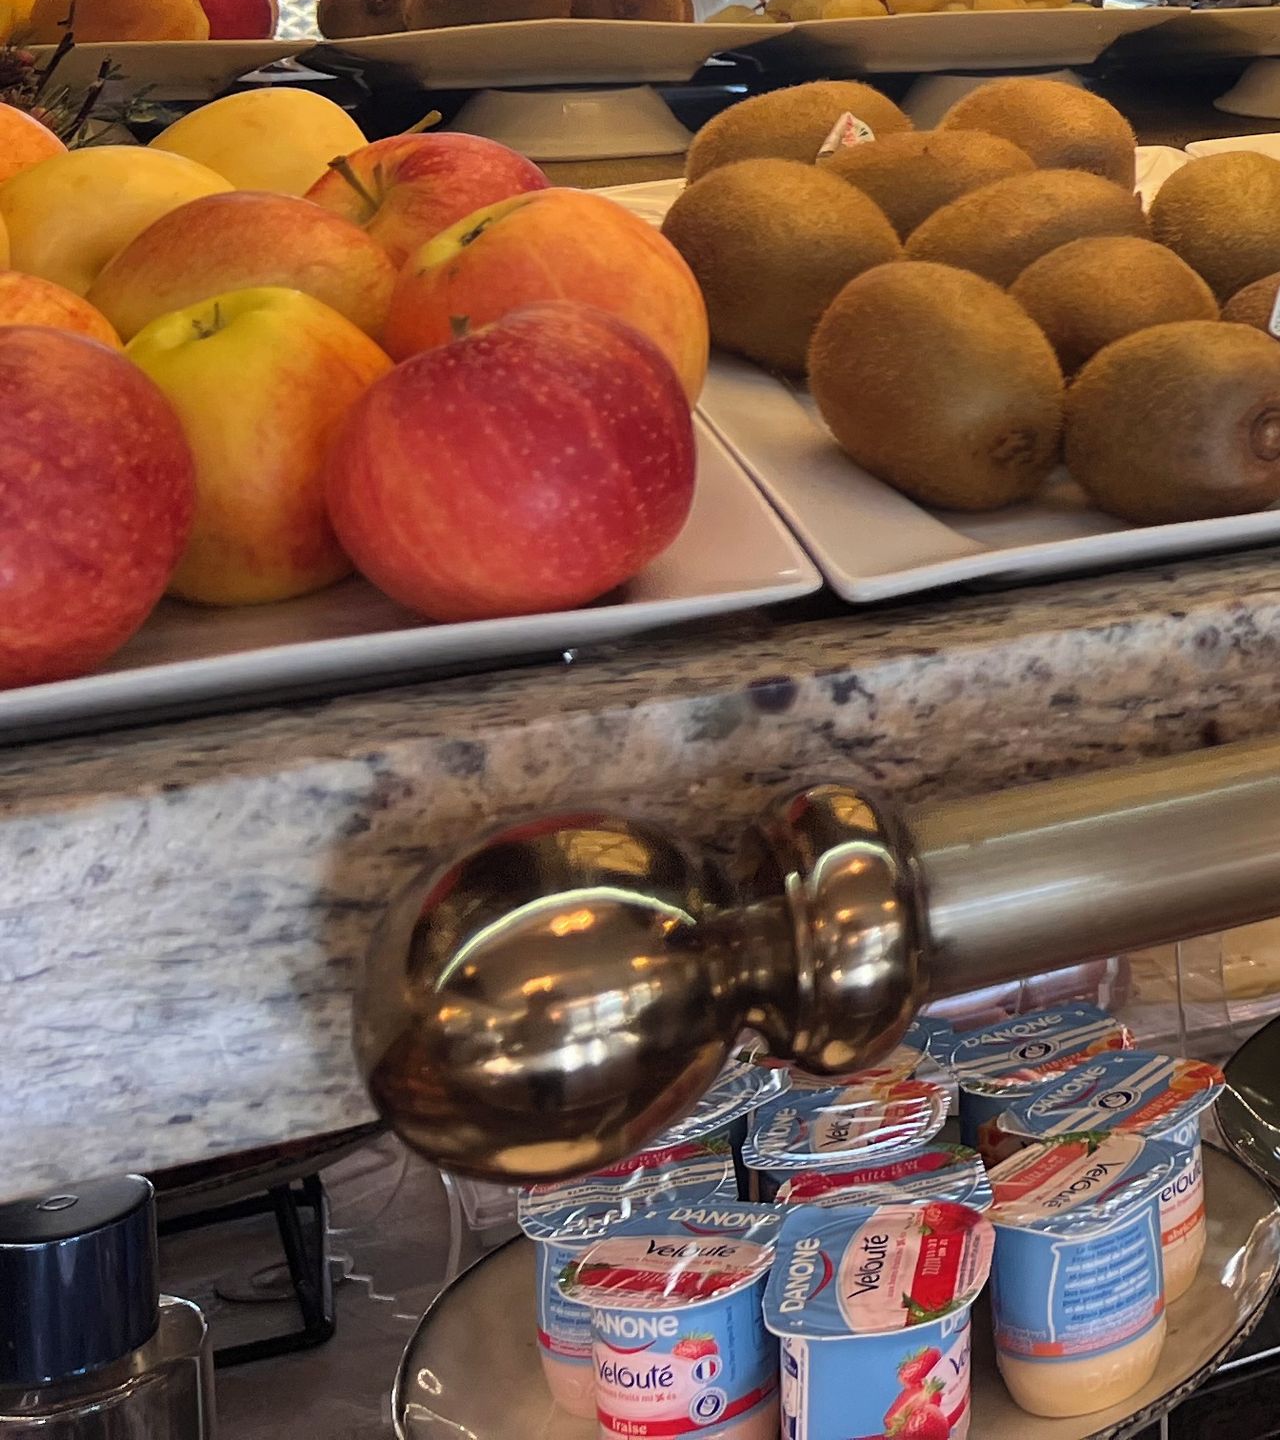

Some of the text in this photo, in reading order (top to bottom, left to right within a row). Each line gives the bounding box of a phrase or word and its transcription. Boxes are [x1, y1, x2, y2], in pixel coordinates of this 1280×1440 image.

[1041, 1162, 1125, 1209] Velouté
[668, 1207, 781, 1227] DANONE
[646, 1239, 738, 1258] Velouté
[847, 1234, 889, 1300] Velouté
[779, 1237, 821, 1313] DANONE
